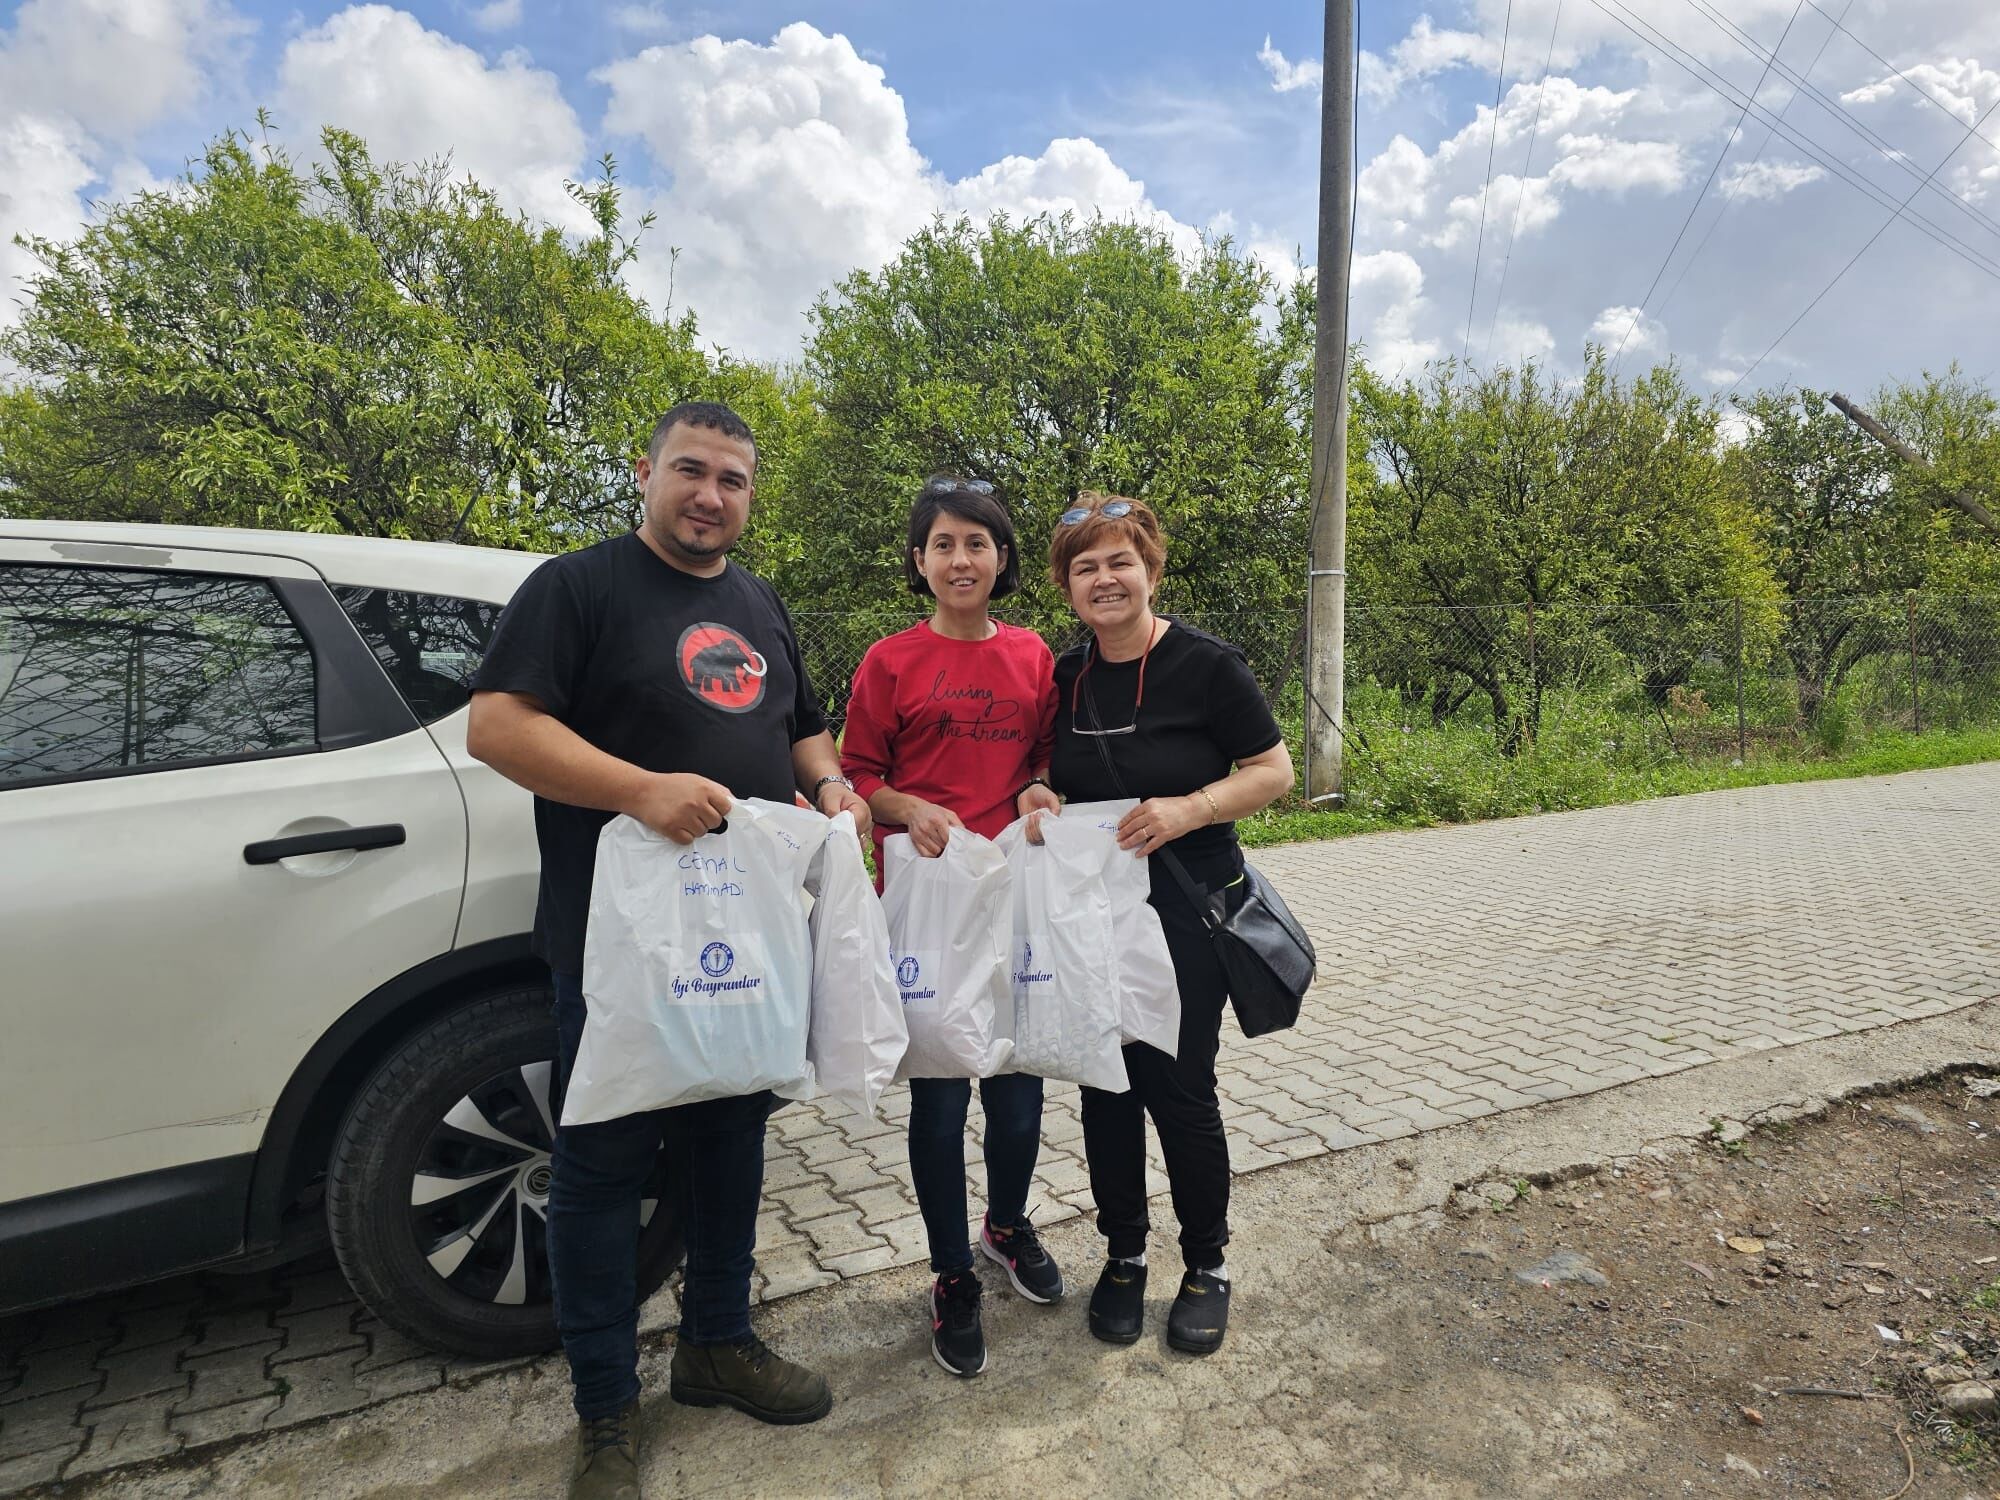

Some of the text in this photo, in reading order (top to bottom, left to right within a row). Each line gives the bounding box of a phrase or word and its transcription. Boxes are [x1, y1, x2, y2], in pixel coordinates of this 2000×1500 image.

[932, 670, 993, 717] living
[935, 710, 1027, 742] the dream
[691, 975, 761, 997] Bayramlar
